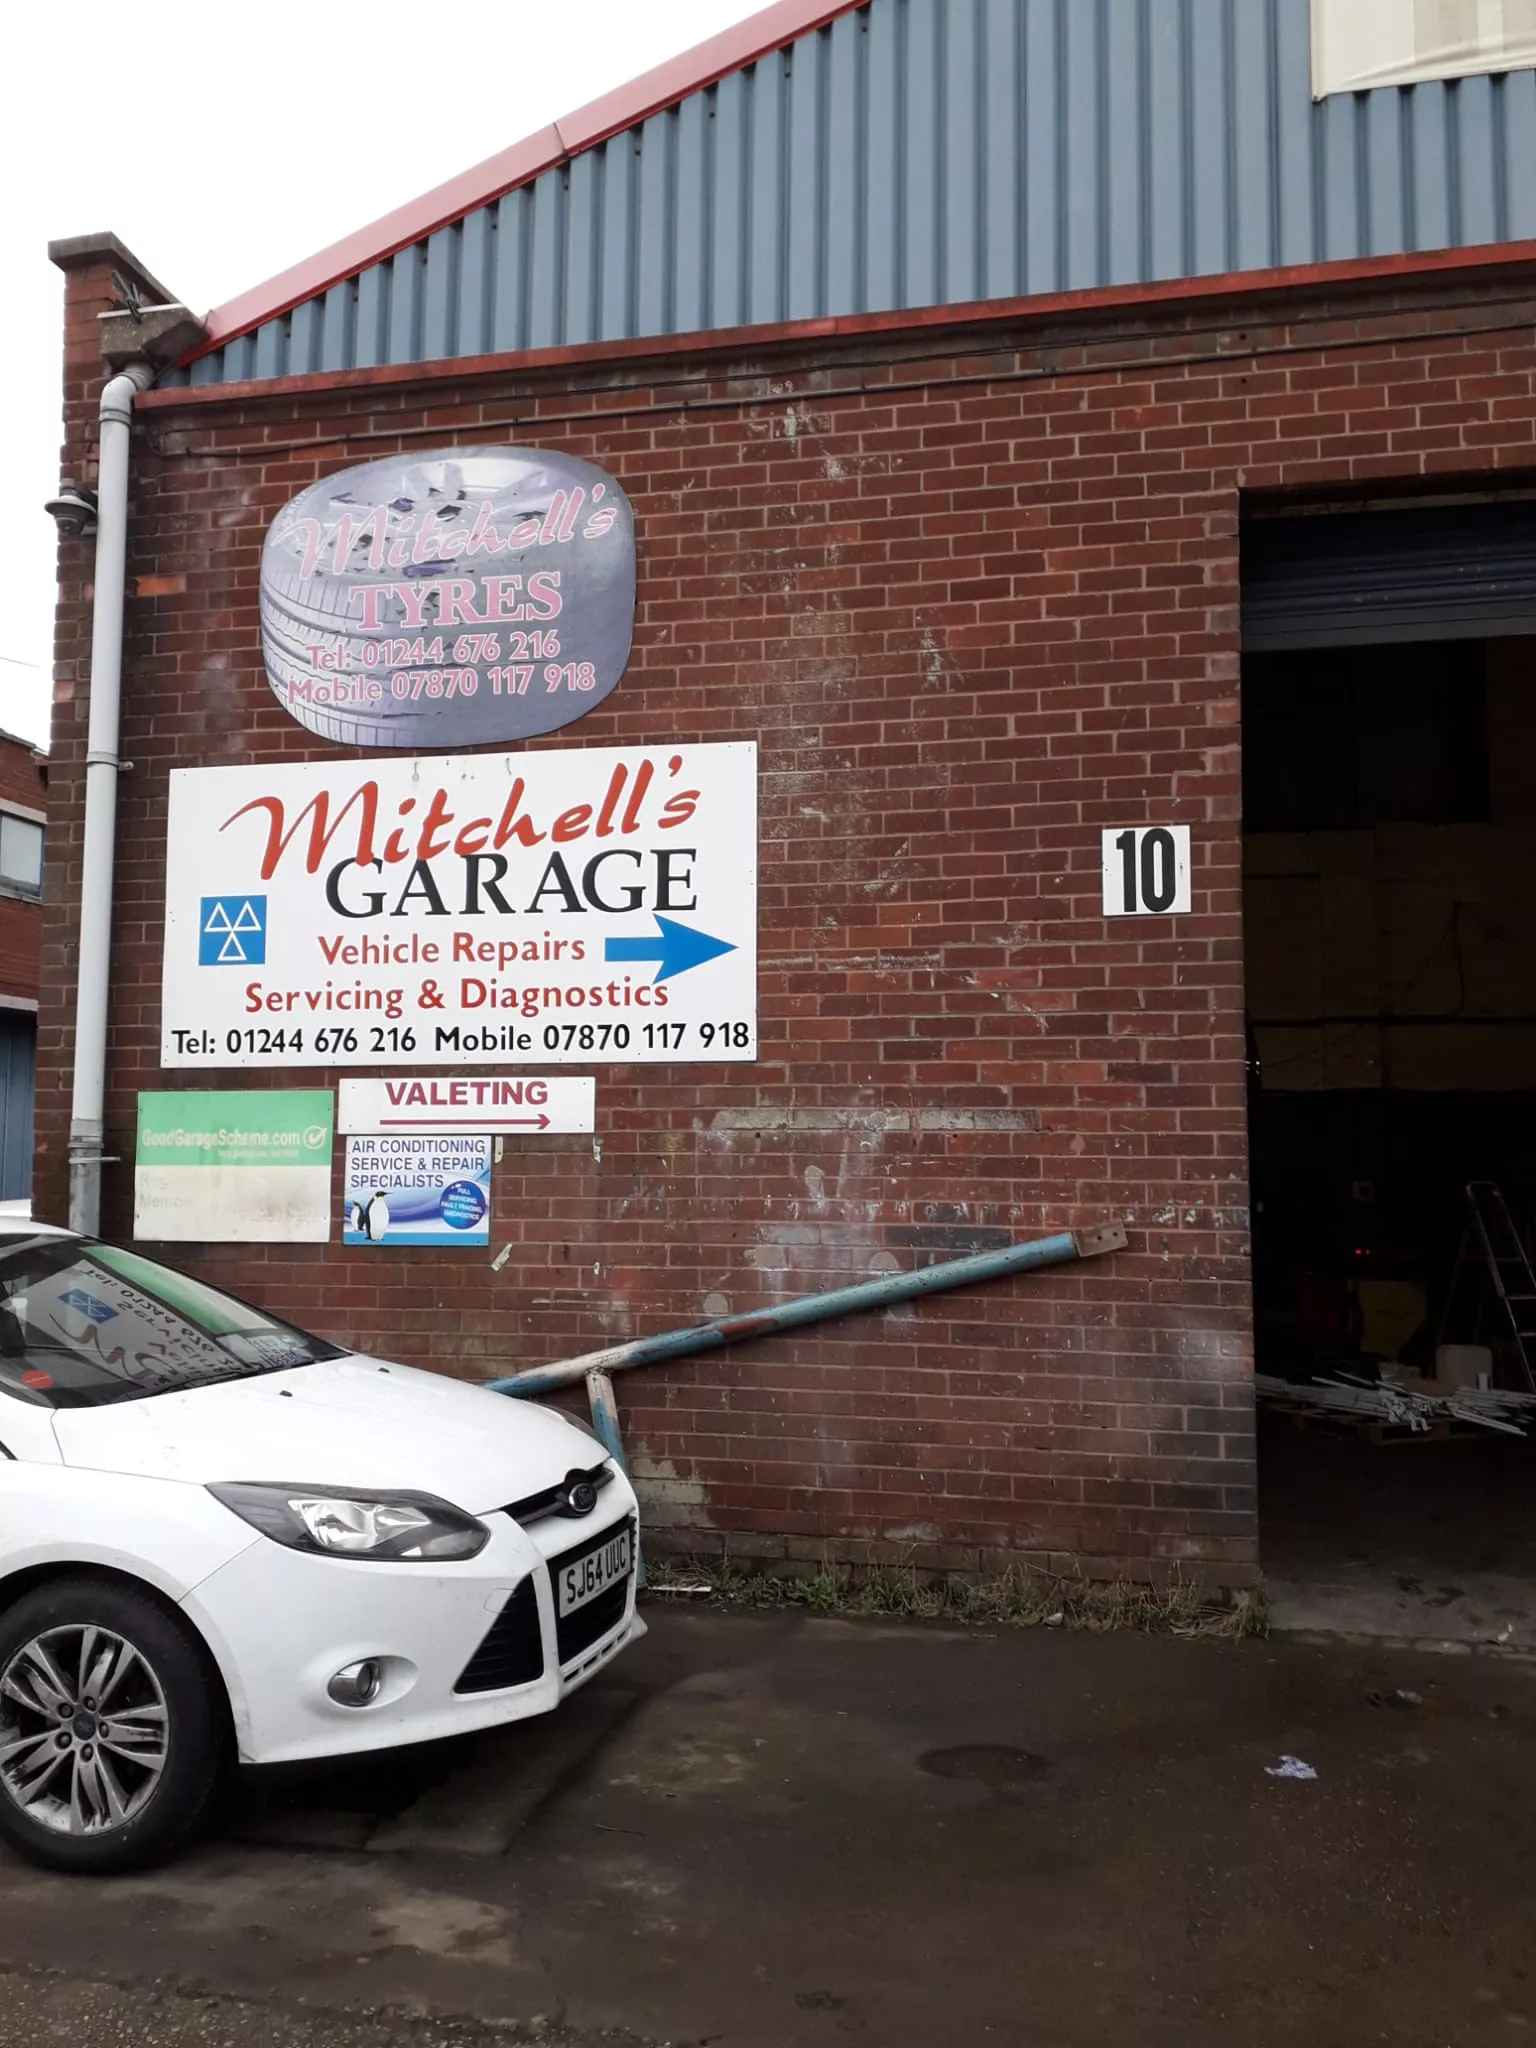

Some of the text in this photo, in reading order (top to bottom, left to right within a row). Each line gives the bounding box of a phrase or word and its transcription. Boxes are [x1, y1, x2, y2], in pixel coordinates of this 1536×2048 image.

[272, 484, 617, 581] Mitchell's
[349, 572, 563, 631] TYRES
[306, 629, 560, 670] Tel: 01244 676 216
[288, 662, 596, 705] Mobile 07870 117 918
[218, 754, 701, 880] Mitchell's
[325, 847, 698, 919] GARAGE
[1116, 828, 1176, 912] 10
[318, 930, 585, 971] Vehicle Repairs
[245, 976, 668, 1019] Servicing & Diagnostics
[171, 1021, 749, 1053] Tel: 01244 676 216 Mobile 07870 117 918
[385, 1080, 549, 1106] VALETING
[351, 1157, 484, 1170] SERVICE & REPAIR
[352, 1139, 486, 1154] AIR CONDITIONING
[351, 1174, 444, 1188] SPECIALISTS
[566, 1553, 603, 1604] SJ64
